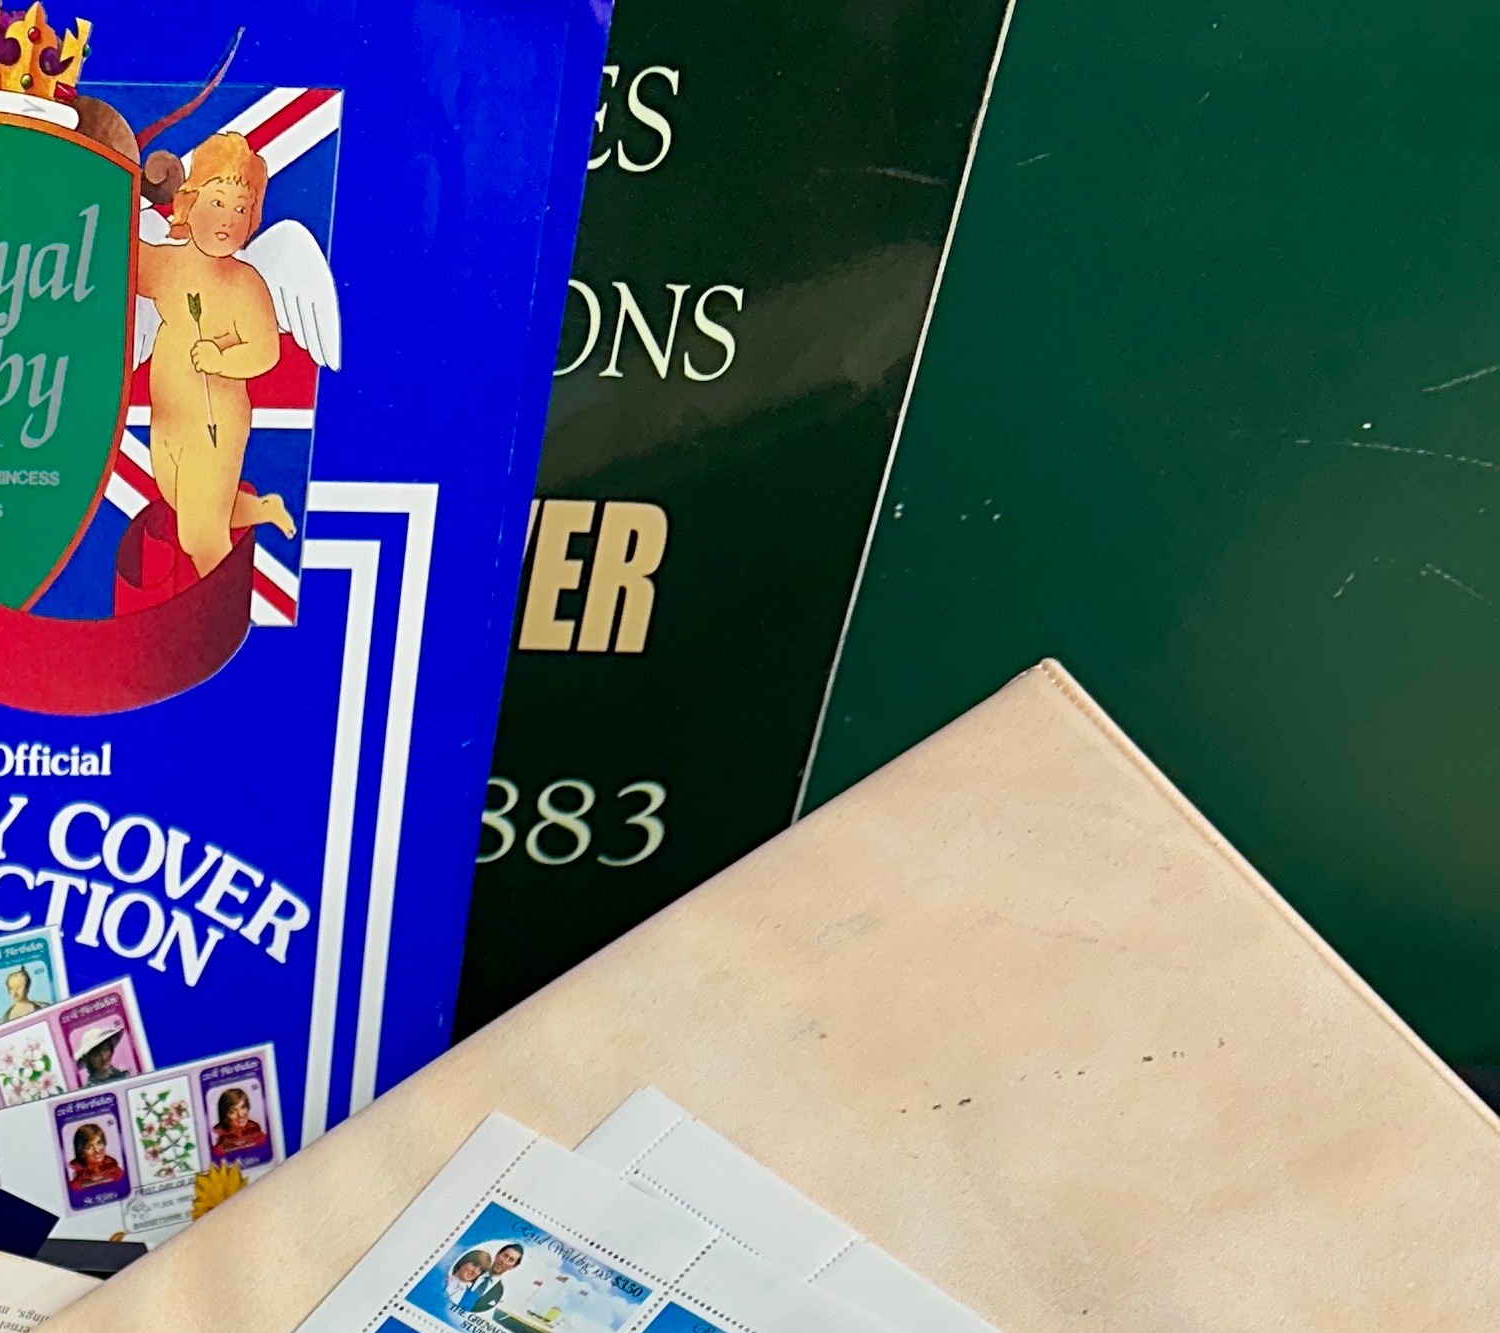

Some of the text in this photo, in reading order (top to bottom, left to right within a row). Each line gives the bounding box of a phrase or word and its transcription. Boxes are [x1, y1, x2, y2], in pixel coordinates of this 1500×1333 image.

[519, 498, 668, 654] ER
[48, 801, 311, 964] COVER
[449, 1302, 469, 1318] THE
